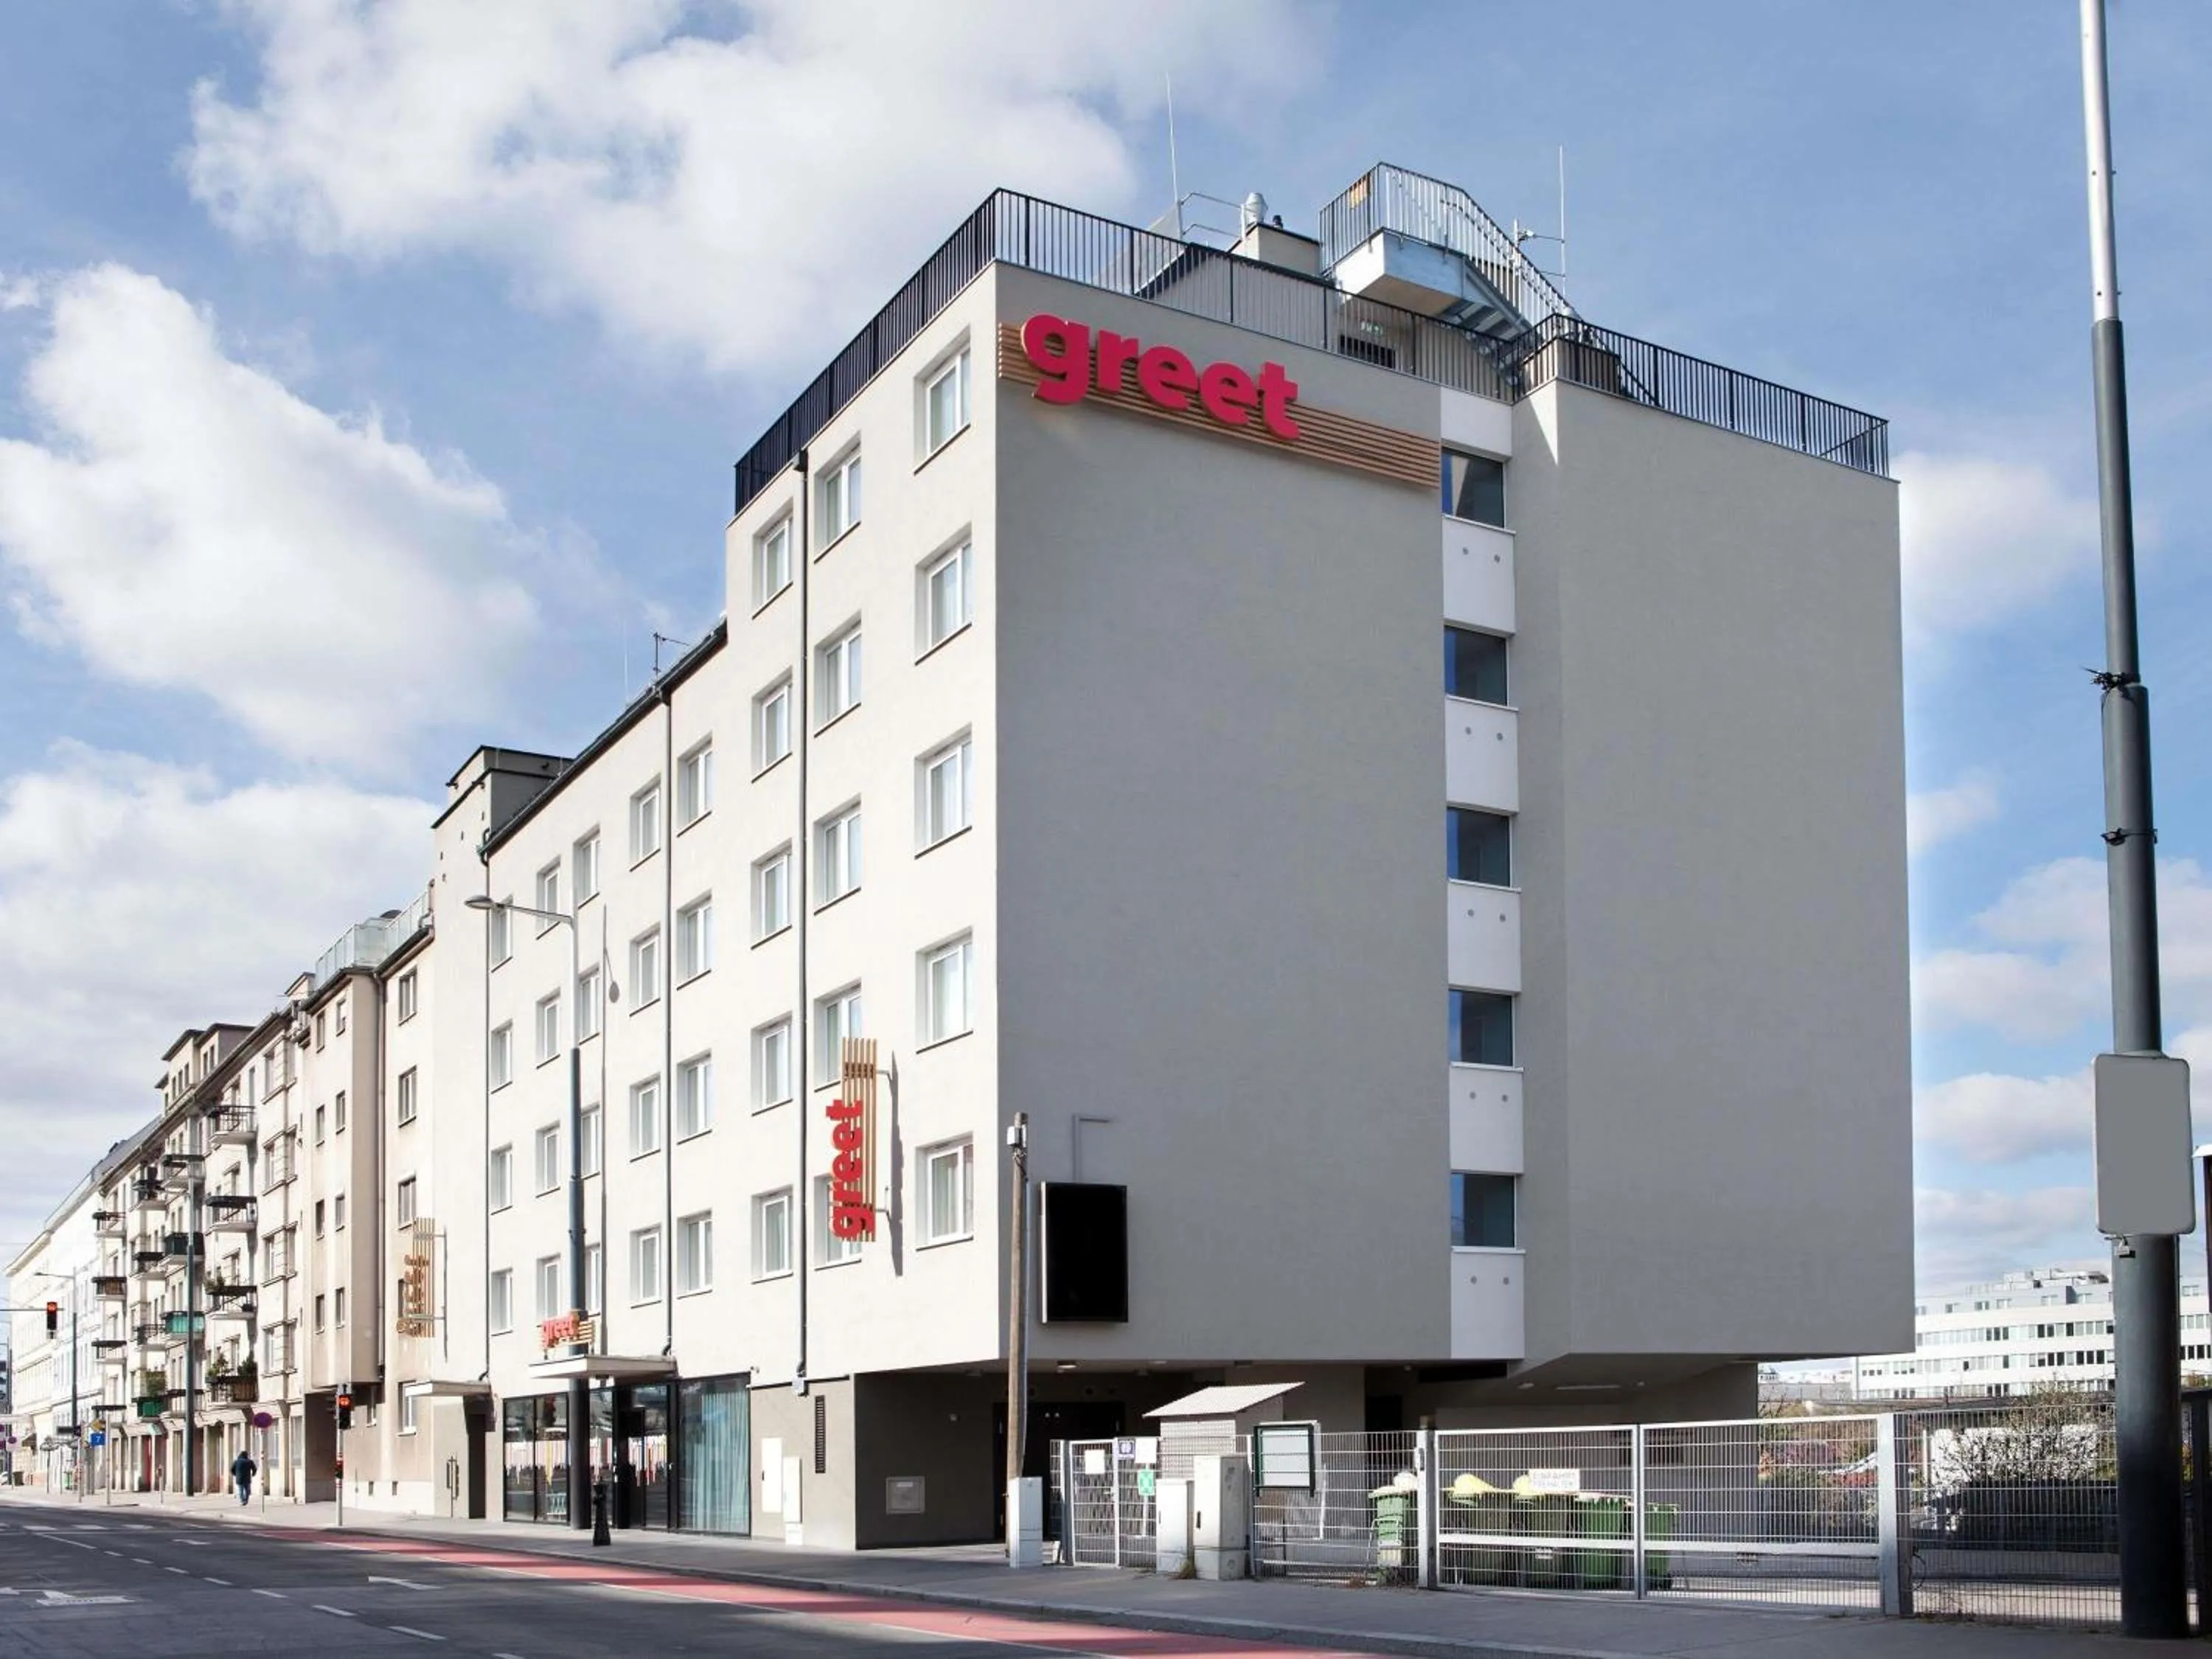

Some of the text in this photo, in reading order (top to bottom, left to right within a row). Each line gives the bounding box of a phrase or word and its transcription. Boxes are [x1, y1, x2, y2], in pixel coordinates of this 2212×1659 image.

[1020, 313, 1301, 441] greet
[825, 1099, 874, 1239] greet
[542, 1312, 578, 1350] greet
